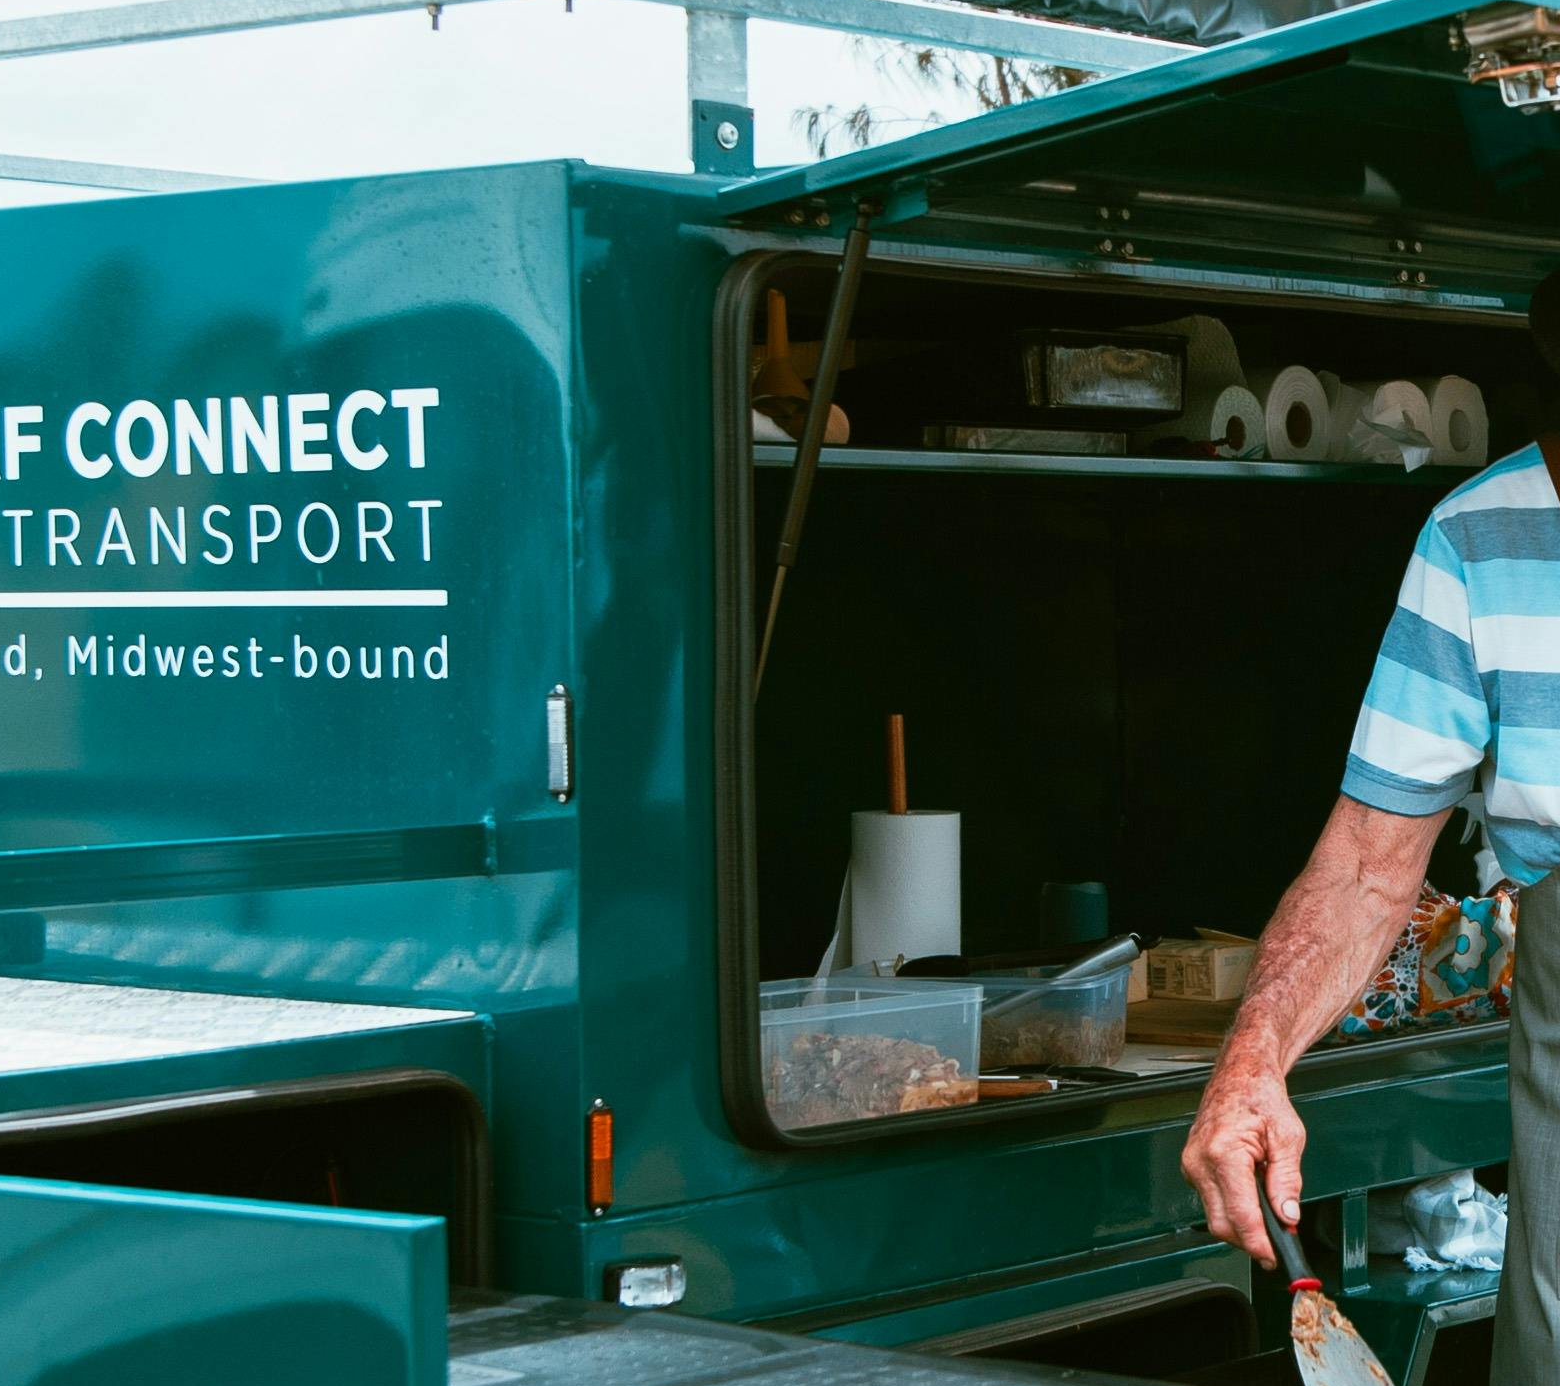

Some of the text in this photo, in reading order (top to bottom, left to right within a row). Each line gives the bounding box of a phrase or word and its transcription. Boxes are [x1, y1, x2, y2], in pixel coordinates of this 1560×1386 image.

[65, 388, 440, 480] CONNECT
[2, 501, 443, 567] TRANSPORT
[68, 633, 449, 680] Midwest-bound
